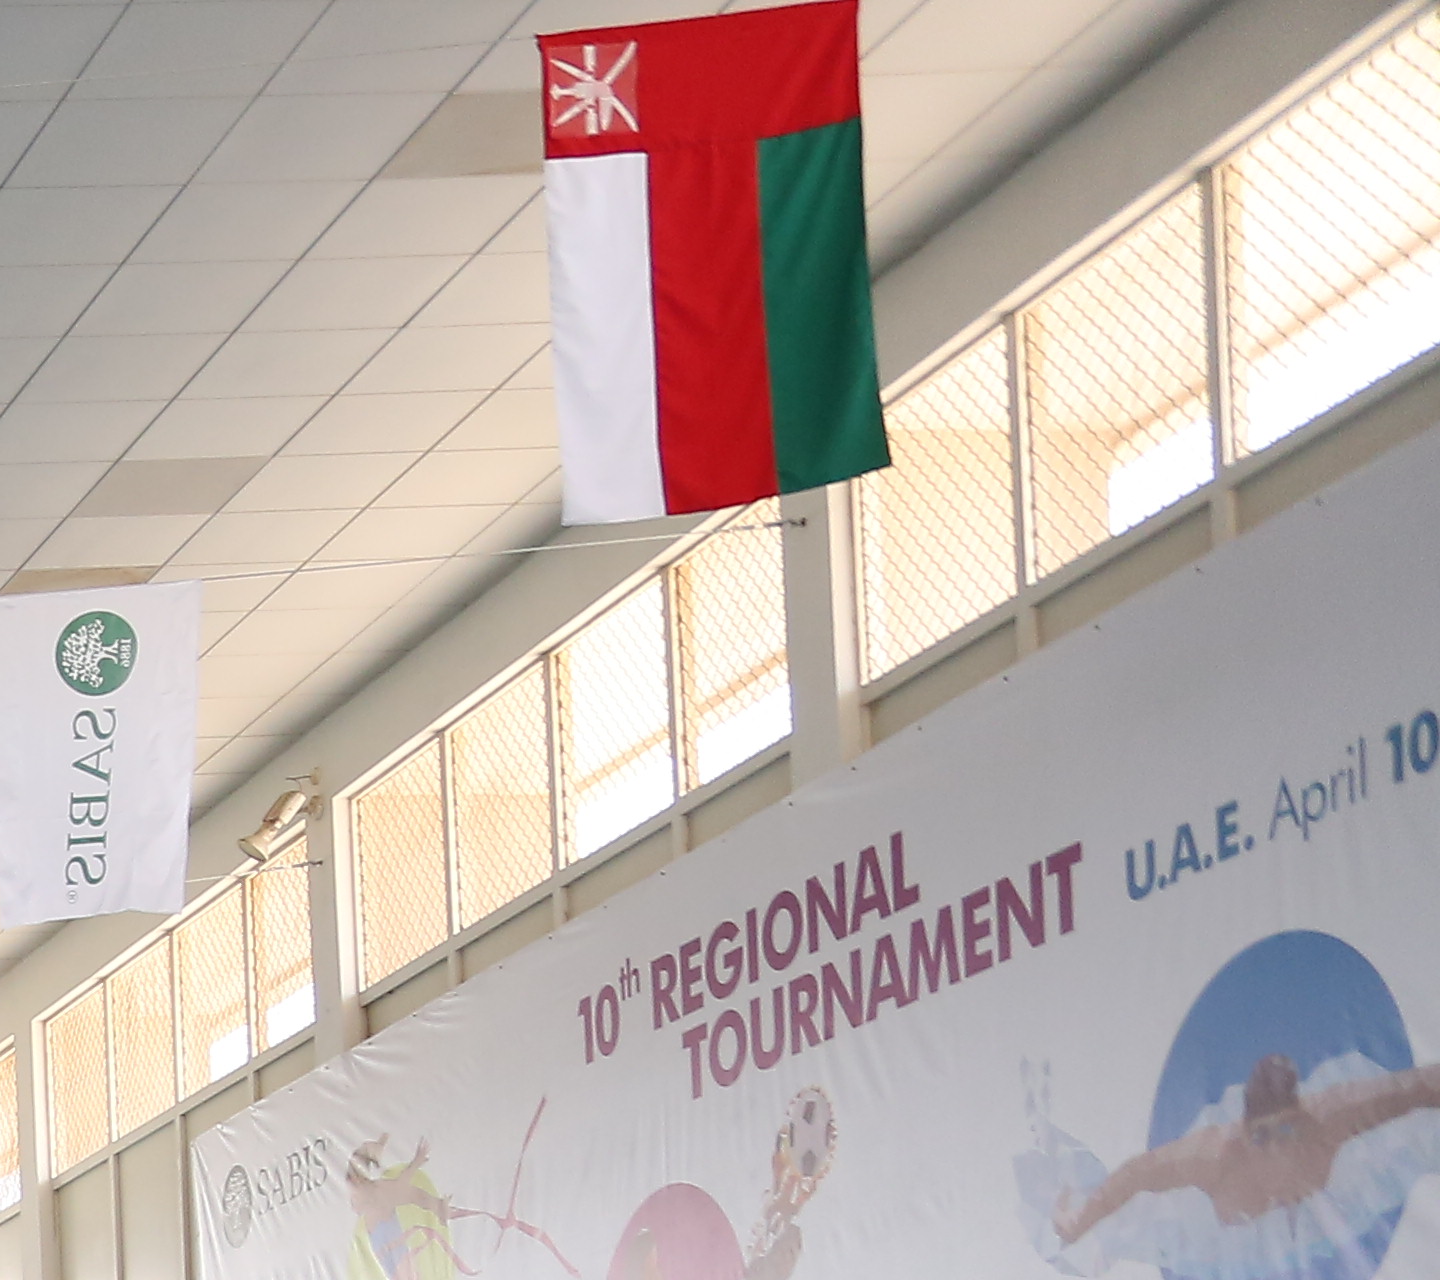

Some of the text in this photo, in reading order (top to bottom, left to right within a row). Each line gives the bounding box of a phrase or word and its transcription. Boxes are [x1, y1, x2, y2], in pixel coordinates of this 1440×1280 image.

[1125, 800, 1255, 901] U.A.E.
[1268, 735, 1367, 842] April
[577, 830, 921, 1065] 10th REGIONAL
[682, 840, 1083, 1101] TOURNAMENT
[256, 1138, 328, 1216] SABIS
